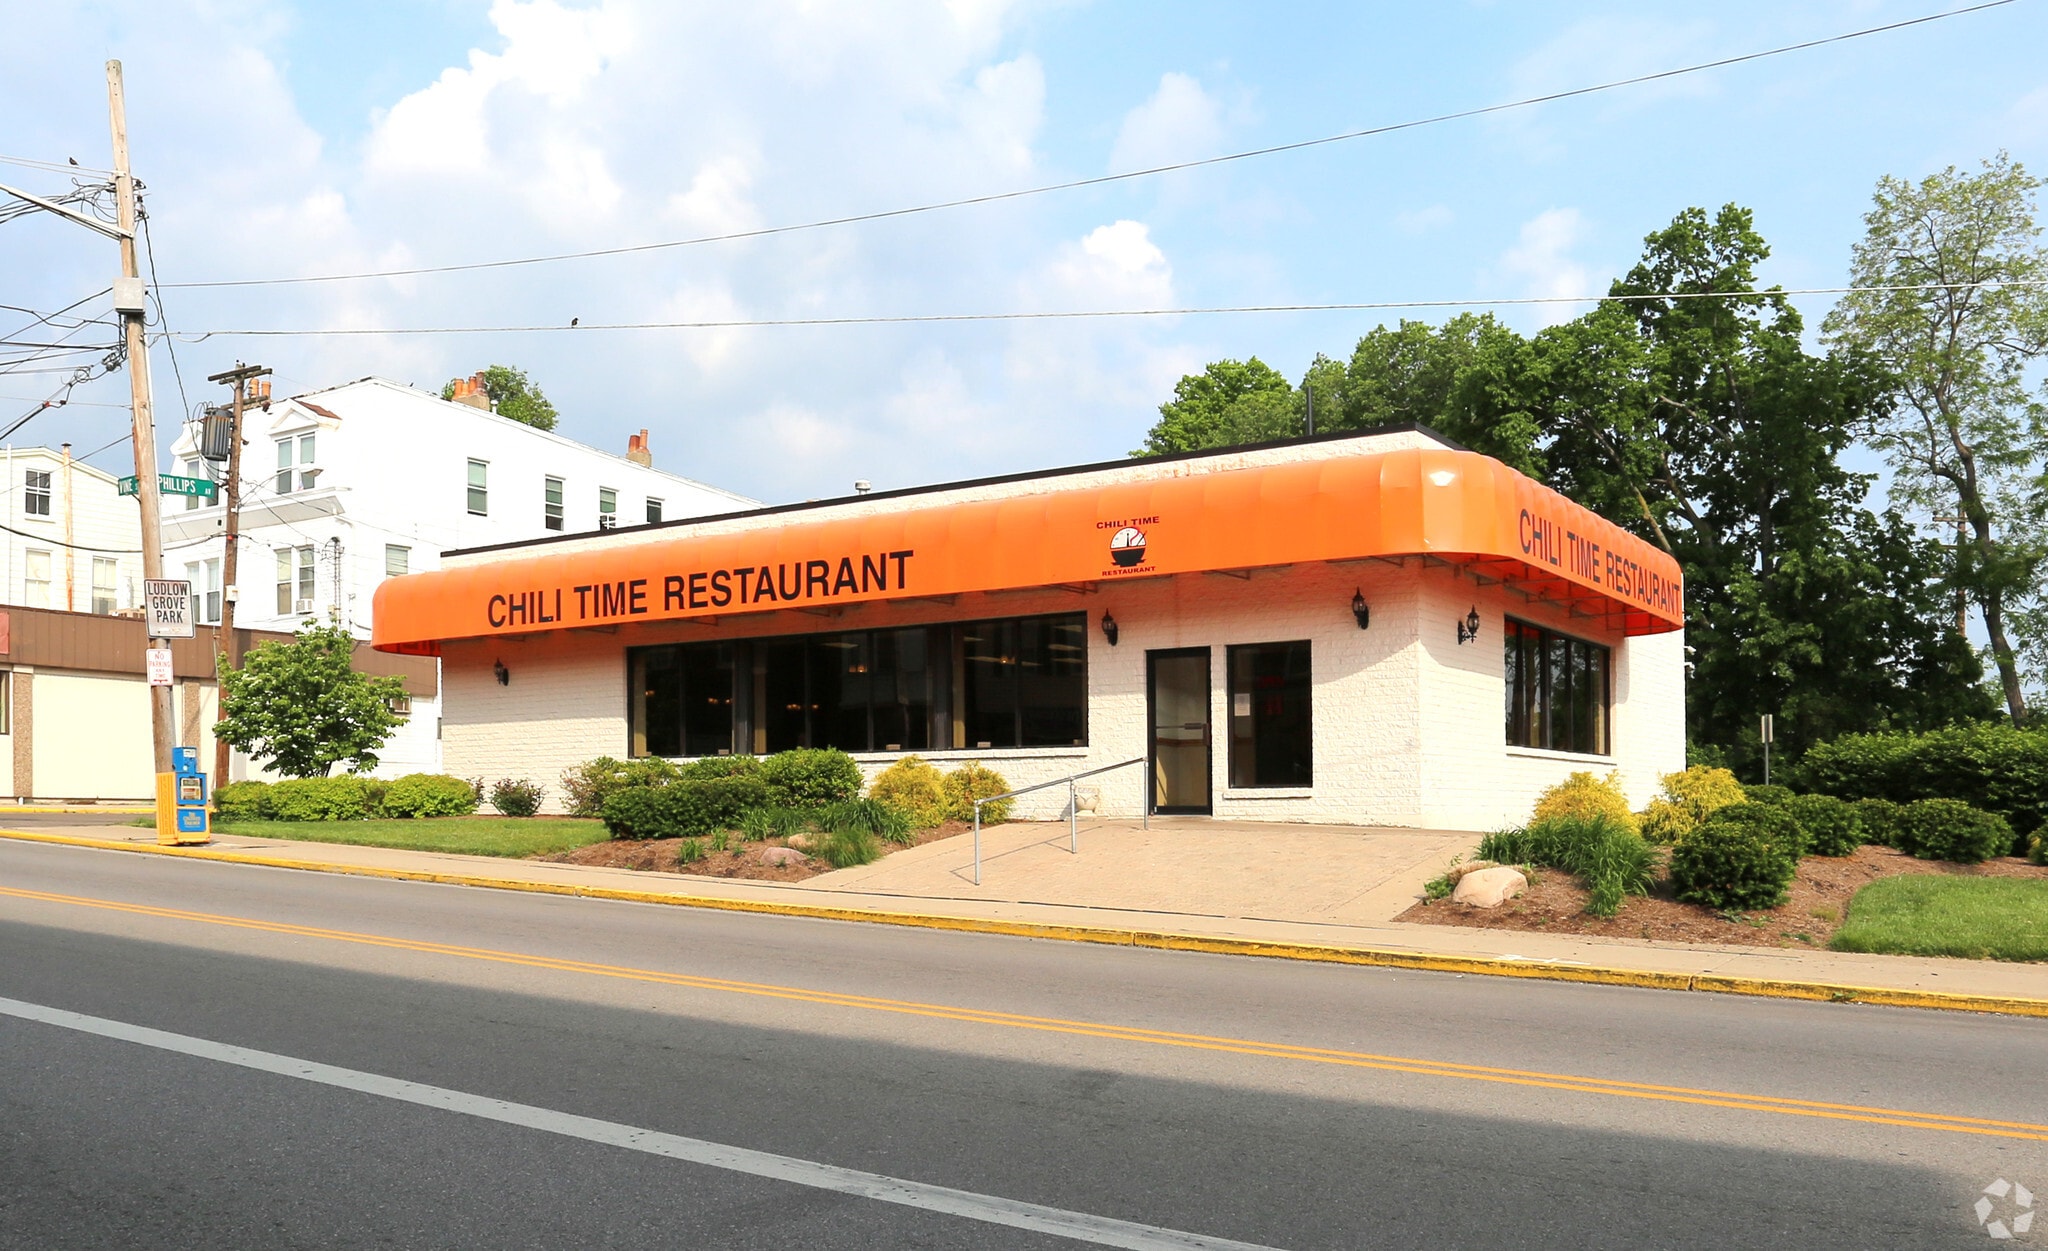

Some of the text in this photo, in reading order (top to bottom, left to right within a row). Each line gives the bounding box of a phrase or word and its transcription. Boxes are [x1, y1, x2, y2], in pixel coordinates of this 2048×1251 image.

[119, 479, 133, 494] VINE
[159, 476, 196, 493] PHILLIPS
[1096, 516, 1160, 529] CHILI TIME
[1520, 508, 1680, 618] CHILI TIME RESTAURANT
[1102, 566, 1156, 576] RESTAURANT
[147, 582, 188, 596] LUDLOW
[487, 550, 914, 628] CHILI TIME RESTAURANT
[152, 596, 186, 610] GROVE
[156, 610, 184, 623] PARK
